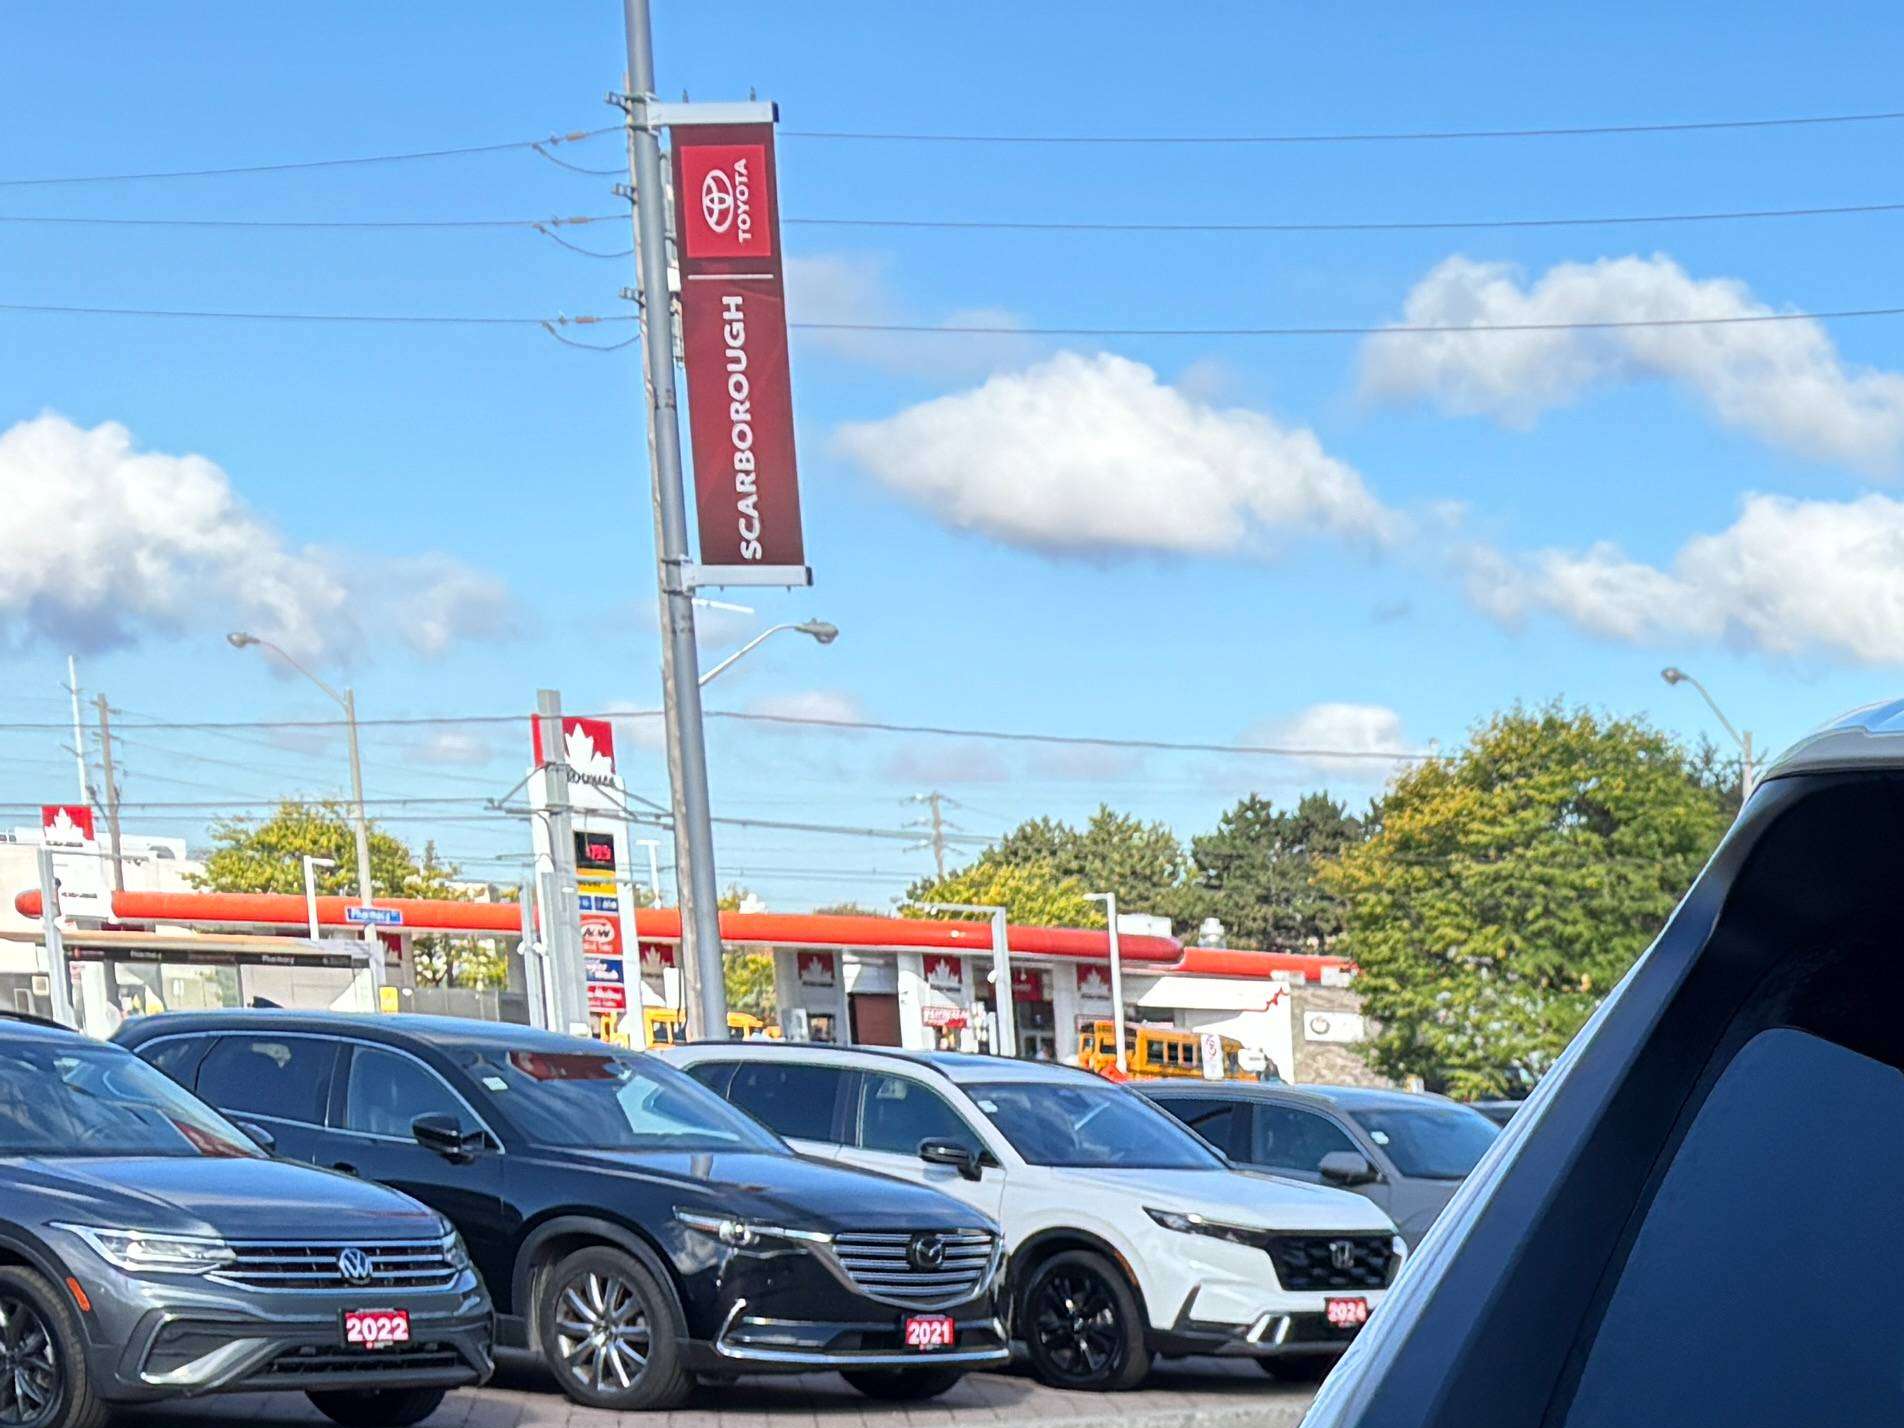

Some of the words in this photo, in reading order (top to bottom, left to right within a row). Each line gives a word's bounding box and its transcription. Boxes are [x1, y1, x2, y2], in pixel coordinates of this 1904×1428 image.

[734, 158, 752, 243] TOYOTA
[722, 296, 762, 560] SCARBOROUGH
[346, 1317, 409, 1342] 2022
[908, 1321, 951, 1345] 2021
